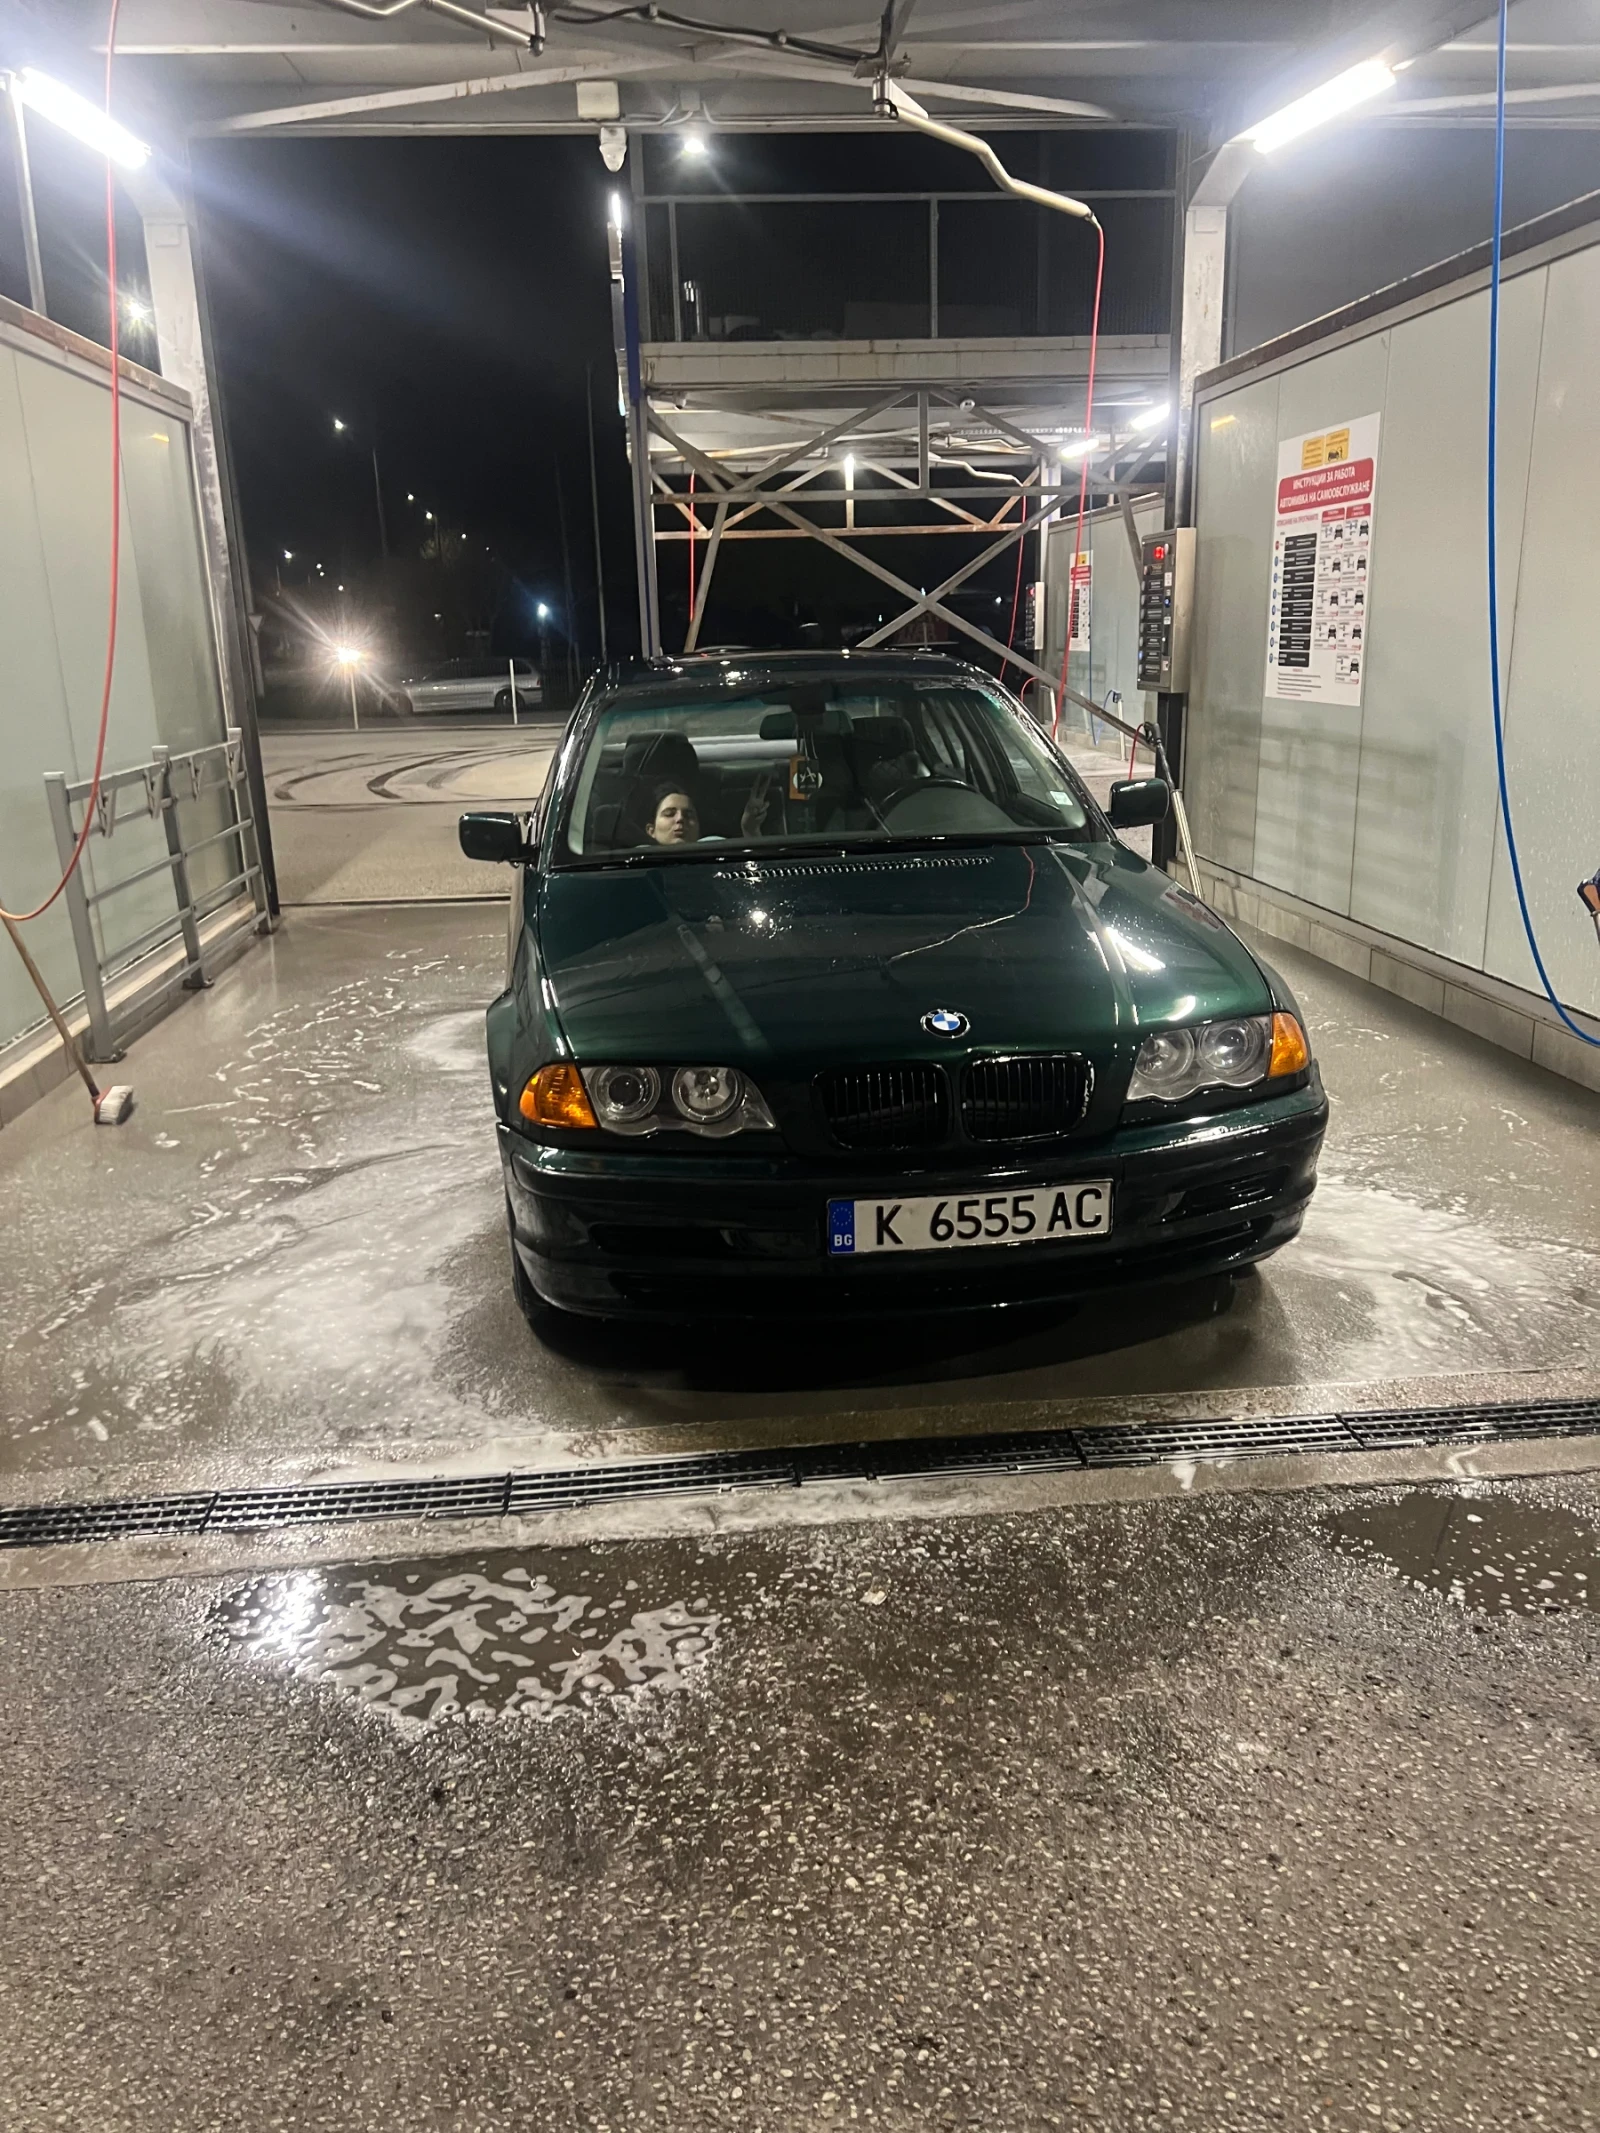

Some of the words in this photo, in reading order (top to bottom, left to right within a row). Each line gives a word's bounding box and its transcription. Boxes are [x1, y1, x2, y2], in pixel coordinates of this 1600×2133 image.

[1293, 473, 1327, 490] ИНСТРУКЦИИ
[1327, 471, 1334, 483] ЗА
[1334, 466, 1355, 481] РАБОТА
[1279, 493, 1309, 508] АВТОМИВКА
[1309, 491, 1316, 503] НА
[1317, 480, 1371, 501] САМООБСЛУЖВАНЕ
[876, 1205, 903, 1245] K
[930, 1195, 1036, 1241] 6555
[1047, 1188, 1102, 1232] AC
[834, 1234, 853, 1246] BG
